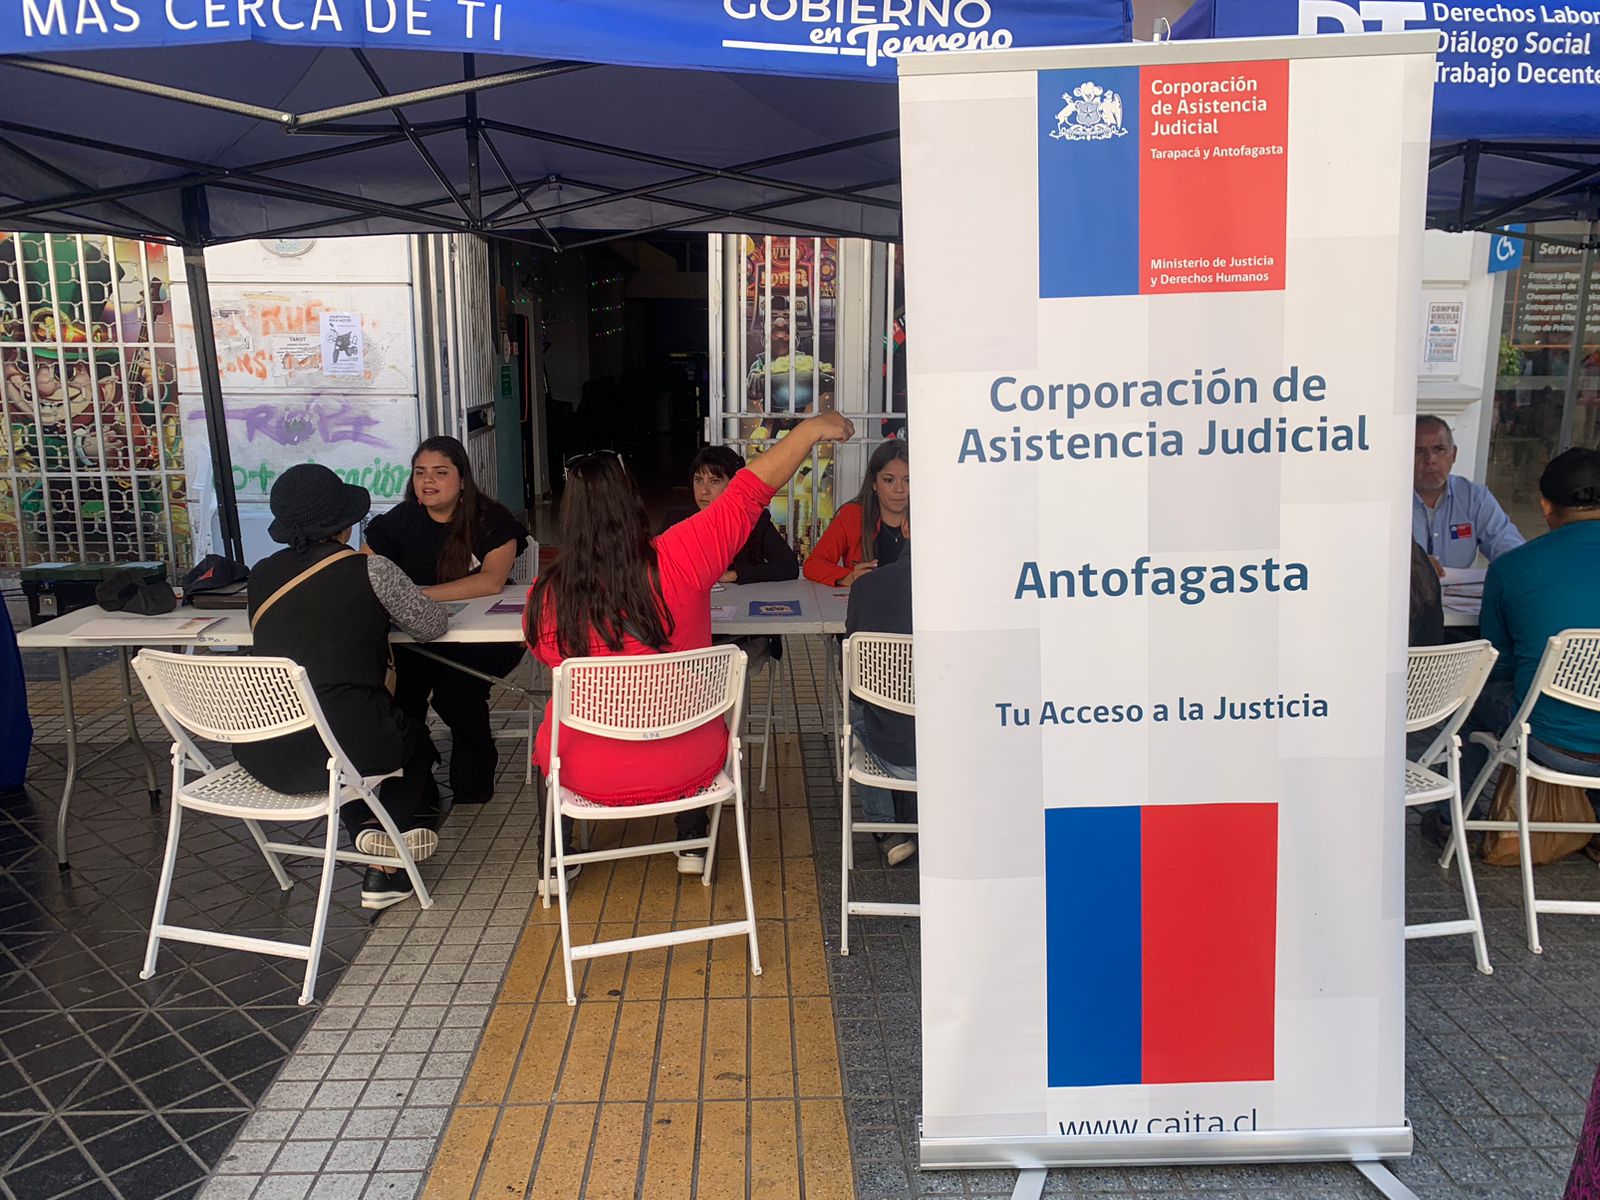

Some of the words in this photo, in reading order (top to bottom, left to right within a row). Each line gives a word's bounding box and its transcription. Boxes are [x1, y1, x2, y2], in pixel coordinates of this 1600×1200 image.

[165, 0, 343, 31] CERCA
[364, 0, 432, 36] DE
[456, 0, 502, 41] TI
[722, 0, 993, 28] GOBIERNO
[1432, 2, 1536, 23] Derechos
[809, 27, 842, 44] en
[846, 23, 1013, 67] Terreno
[1437, 30, 1519, 60] Diálogo
[1524, 32, 1592, 55] Social
[1151, 76, 1258, 98] Corporación
[1434, 61, 1511, 88] Trabajo
[1517, 62, 1600, 84] Decente
[1151, 100, 1173, 116] de
[1176, 96, 1268, 115] Asistencia
[1151, 118, 1219, 136] Judicial
[1150, 146, 1201, 160] Tarapacá
[1203, 148, 1211, 160] y
[1212, 144, 1284, 158] Antofagasta
[1150, 257, 1211, 270] Ministerio
[1212, 257, 1226, 268] de
[1229, 255, 1275, 267] Justicia
[1150, 276, 1158, 288] y
[1160, 272, 1213, 285] Derechos
[1215, 271, 1270, 283] Humanos
[989, 367, 1258, 419] Corporación
[1272, 366, 1327, 403] de
[957, 420, 1184, 465] Asistencia
[1198, 414, 1370, 457] Judicial
[1014, 556, 1310, 606] Antofagasta
[995, 702, 1030, 727] Tu
[1038, 699, 1144, 726] Acceso
[1152, 704, 1170, 722] a
[1178, 697, 1204, 723] la
[1213, 693, 1330, 721] Justicia
